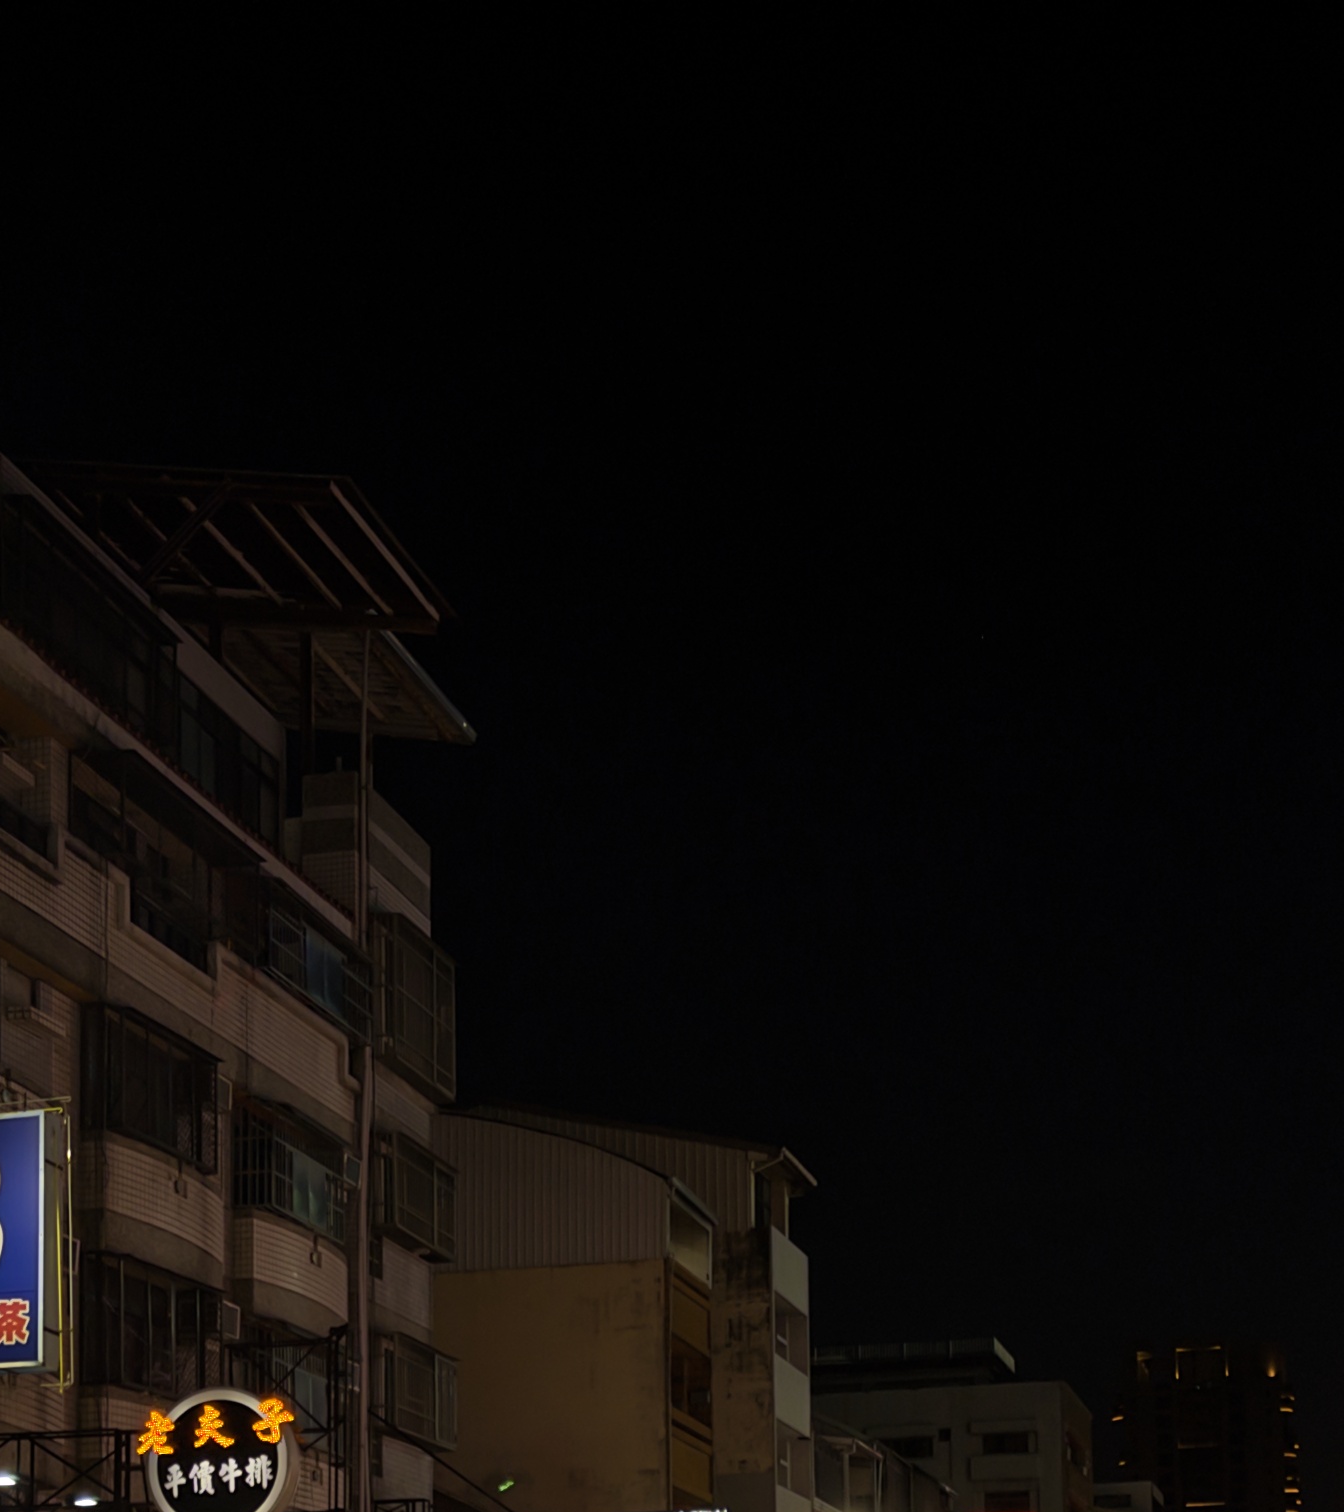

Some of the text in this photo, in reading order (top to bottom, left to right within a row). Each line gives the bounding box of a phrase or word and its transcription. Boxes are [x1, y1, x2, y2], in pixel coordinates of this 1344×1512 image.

[136, 1397, 295, 1455] 老夫子
[164, 1453, 274, 1498] 平價牛排
